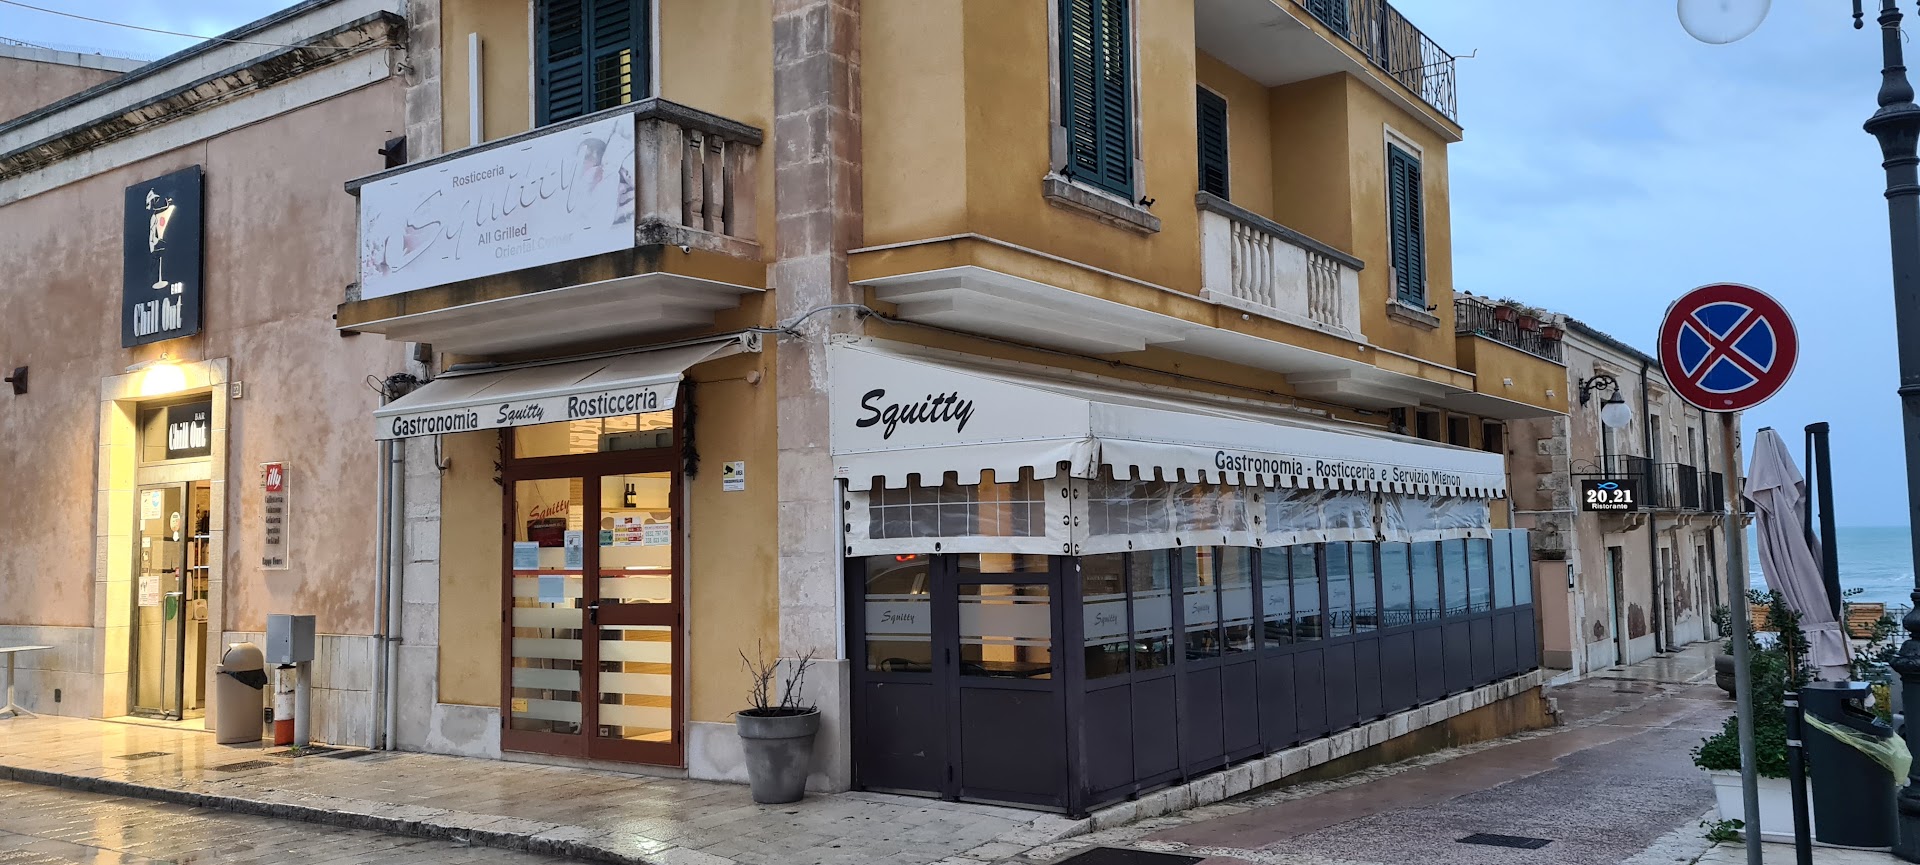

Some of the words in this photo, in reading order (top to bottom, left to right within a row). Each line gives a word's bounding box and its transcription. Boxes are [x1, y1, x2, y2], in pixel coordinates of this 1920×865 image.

[452, 164, 505, 189] Rosticceria
[391, 157, 579, 273] Squitty
[478, 228, 491, 246] All
[493, 223, 527, 245] Grilled
[495, 240, 536, 259] Oriental
[133, 299, 160, 337] Chill
[162, 295, 183, 332] Out
[194, 412, 206, 420] BAR
[391, 407, 478, 438] Gastronomia
[496, 402, 545, 425] Squitty
[568, 387, 657, 419] Rosticceria
[855, 388, 975, 440] Squitty
[168, 421, 189, 451] Chill
[190, 420, 206, 448] Out
[267, 467, 282, 489] illy
[1214, 450, 1303, 475] Gastronomia
[1316, 459, 1376, 481] Rosticceria
[1381, 469, 1387, 481] e
[1393, 466, 1430, 484] Servizio
[1431, 470, 1461, 487] Mignon
[1586, 489, 1634, 504] 20.21
[528, 499, 570, 527] Squitty
[881, 610, 915, 624] Squitty
[1094, 612, 1118, 626] Squitty
